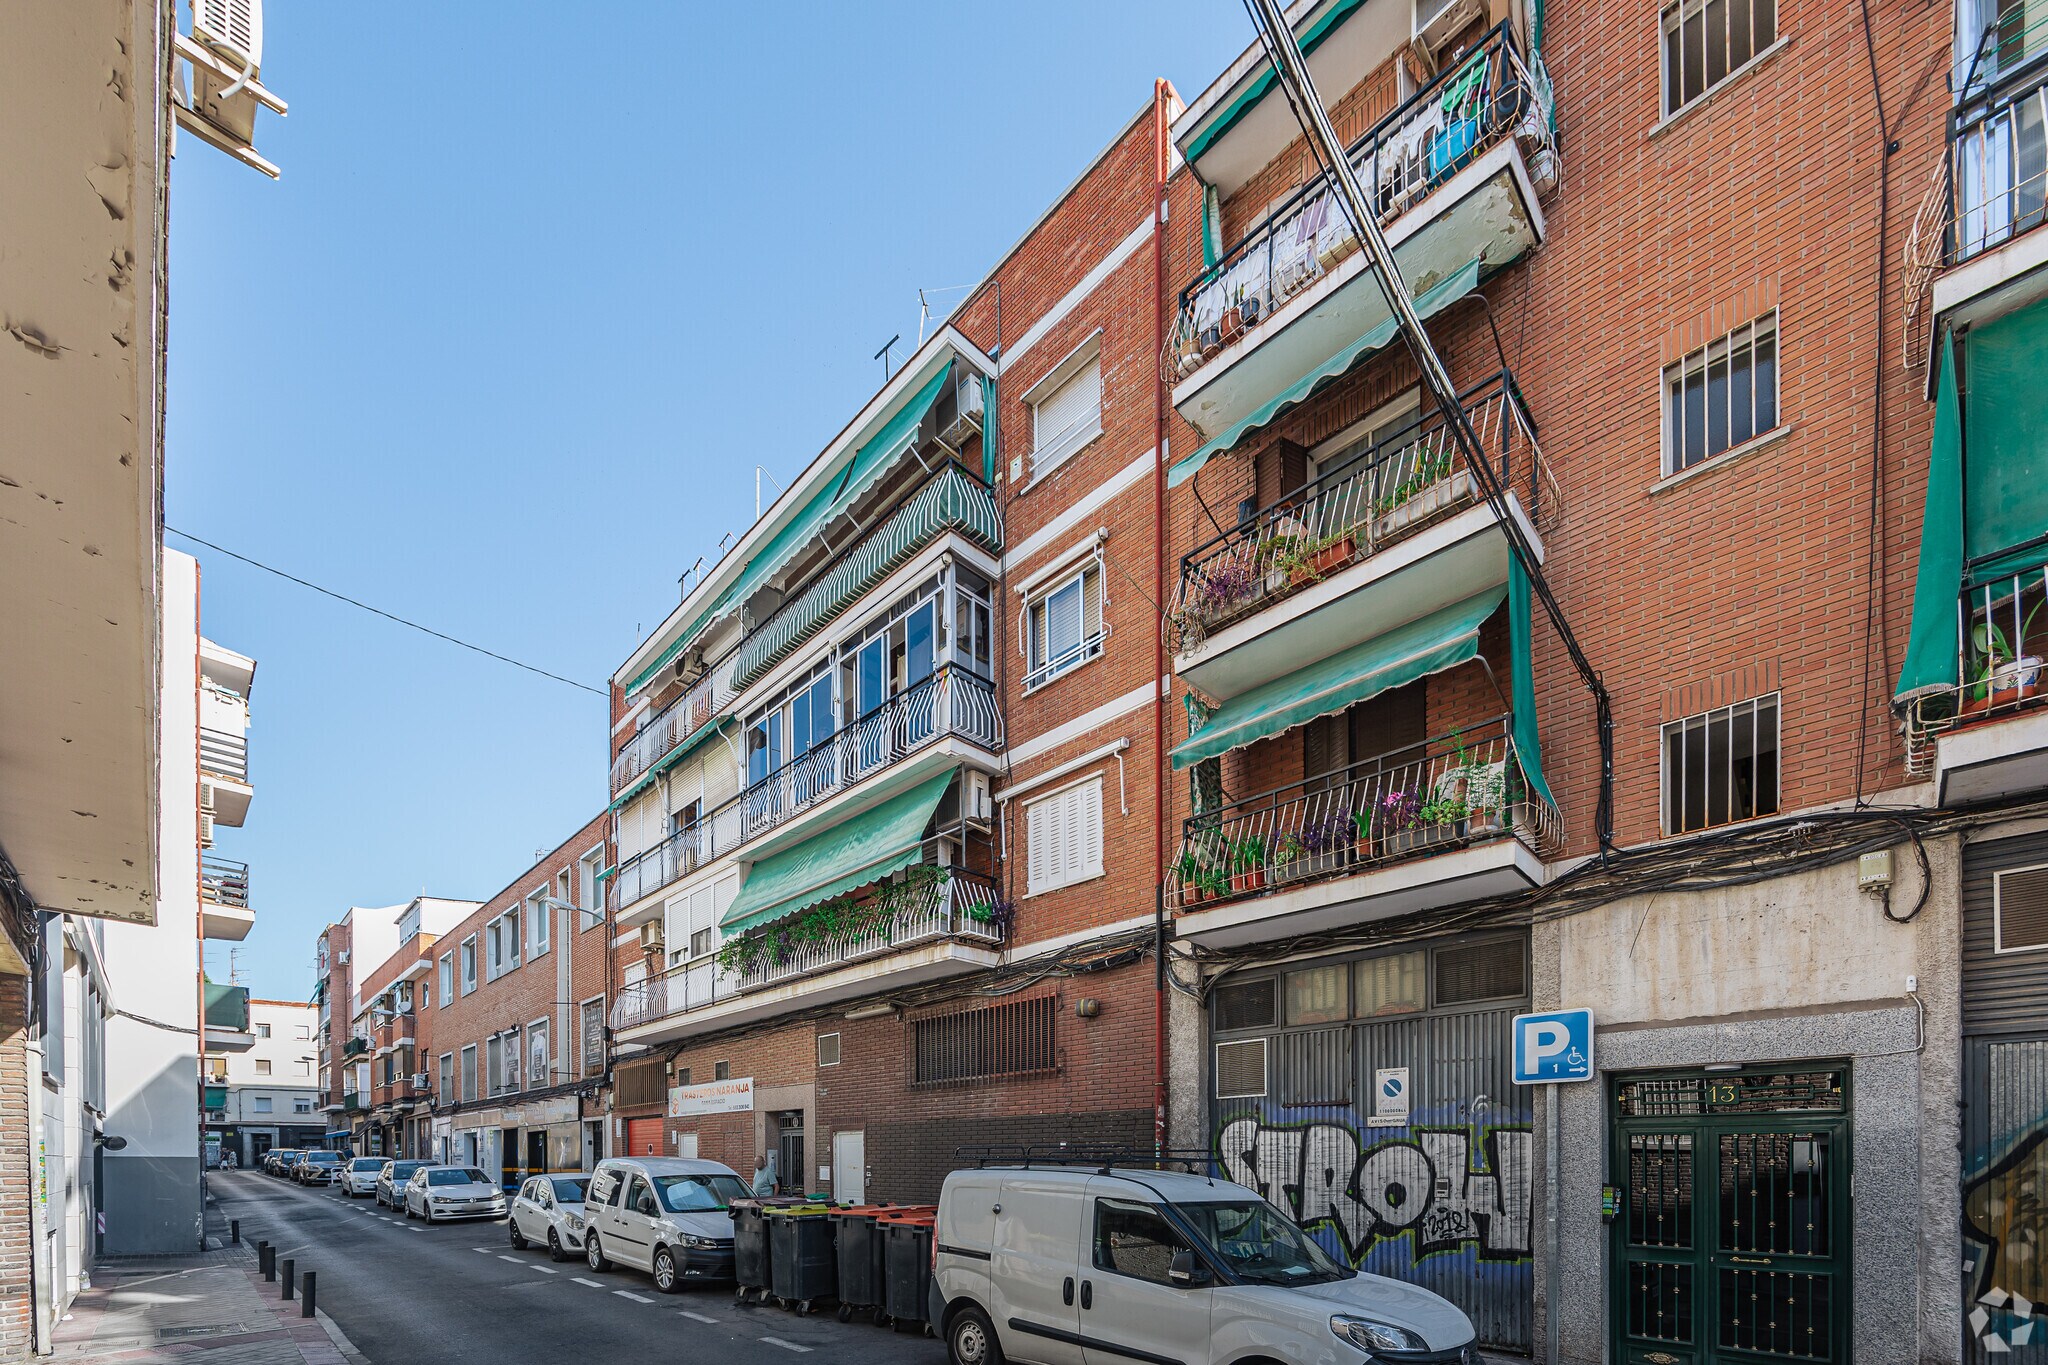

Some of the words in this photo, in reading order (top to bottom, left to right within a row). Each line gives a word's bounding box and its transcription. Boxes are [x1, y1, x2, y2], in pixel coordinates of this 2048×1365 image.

[1525, 1021, 1570, 1074] P
[1553, 1064, 1558, 1073] 1
[716, 1083, 750, 1096] NARANJA
[1709, 1085, 1735, 1103] 13
